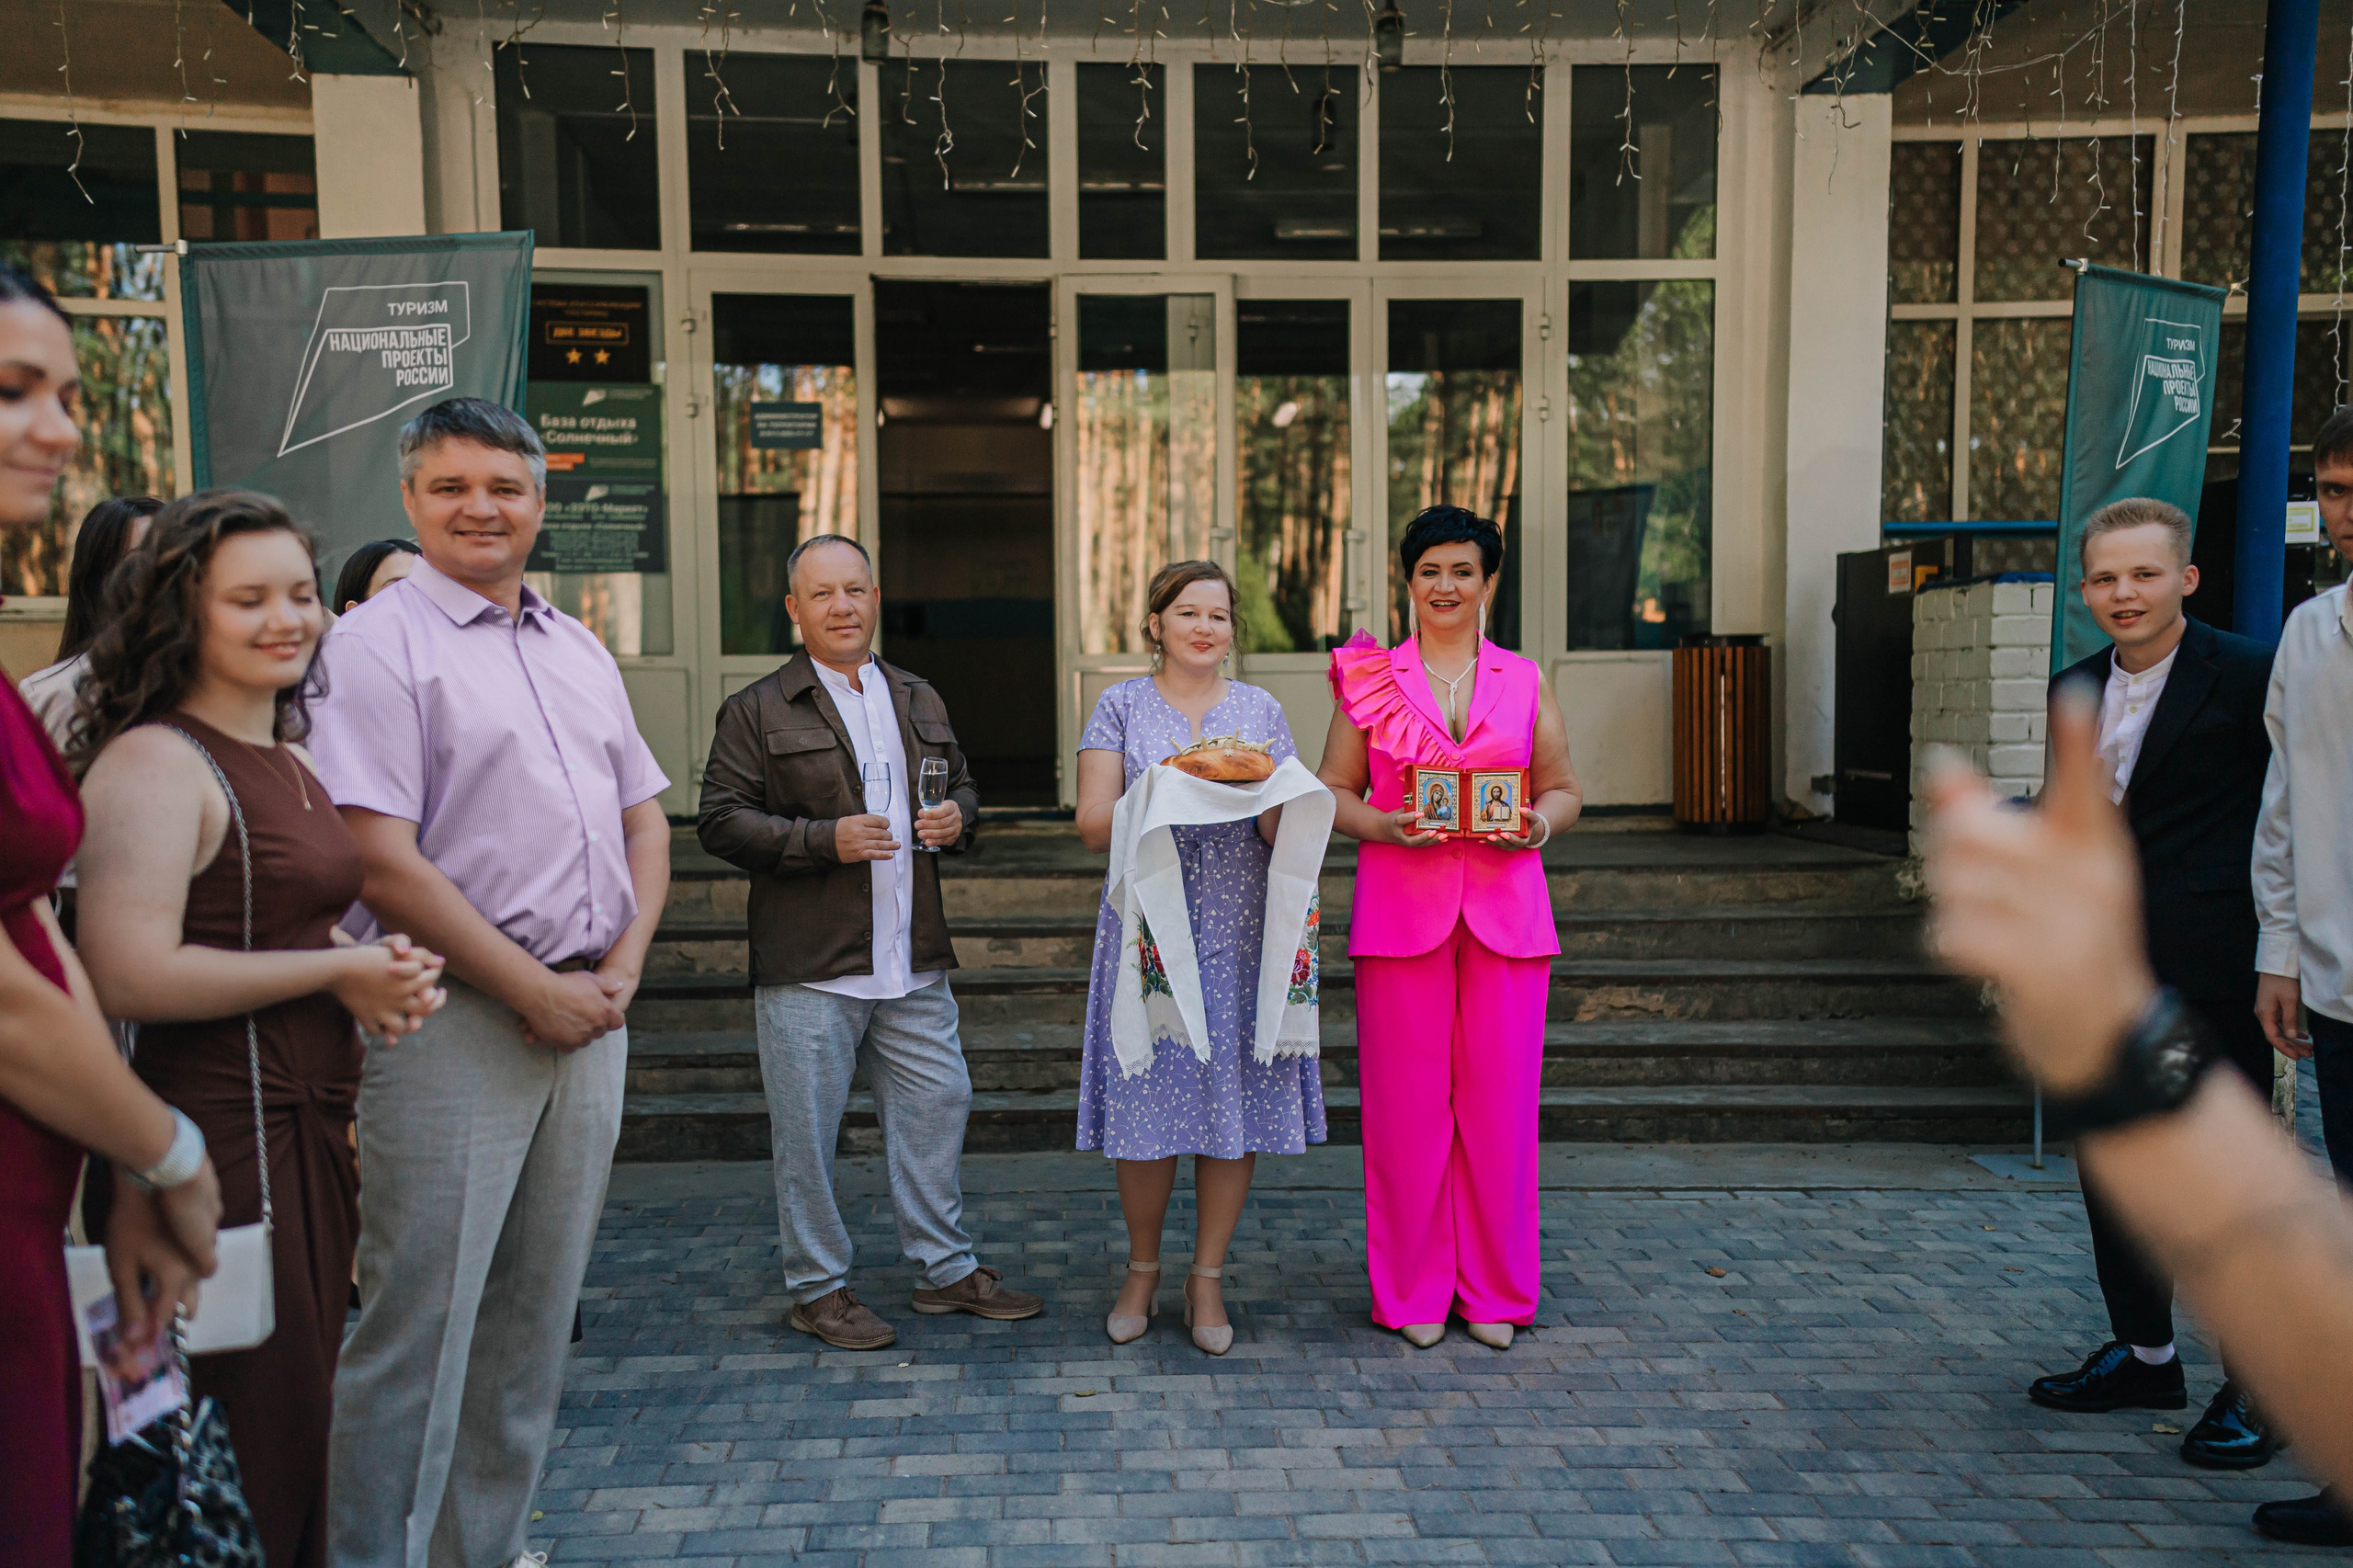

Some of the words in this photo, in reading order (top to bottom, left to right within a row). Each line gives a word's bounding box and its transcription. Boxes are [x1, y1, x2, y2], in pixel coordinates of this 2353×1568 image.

[387, 300, 449, 316] ТУРИЗМ
[329, 328, 447, 354] НАЦИОНАЛЬНЫЕ
[2165, 337, 2196, 352] ТУРИЗМ
[381, 347, 449, 369] ПРОЕКТЫ
[396, 366, 449, 387] РОССИИ
[2174, 395, 2199, 414] РОССИИ
[540, 414, 576, 428] База
[579, 416, 637, 430] отдыха
